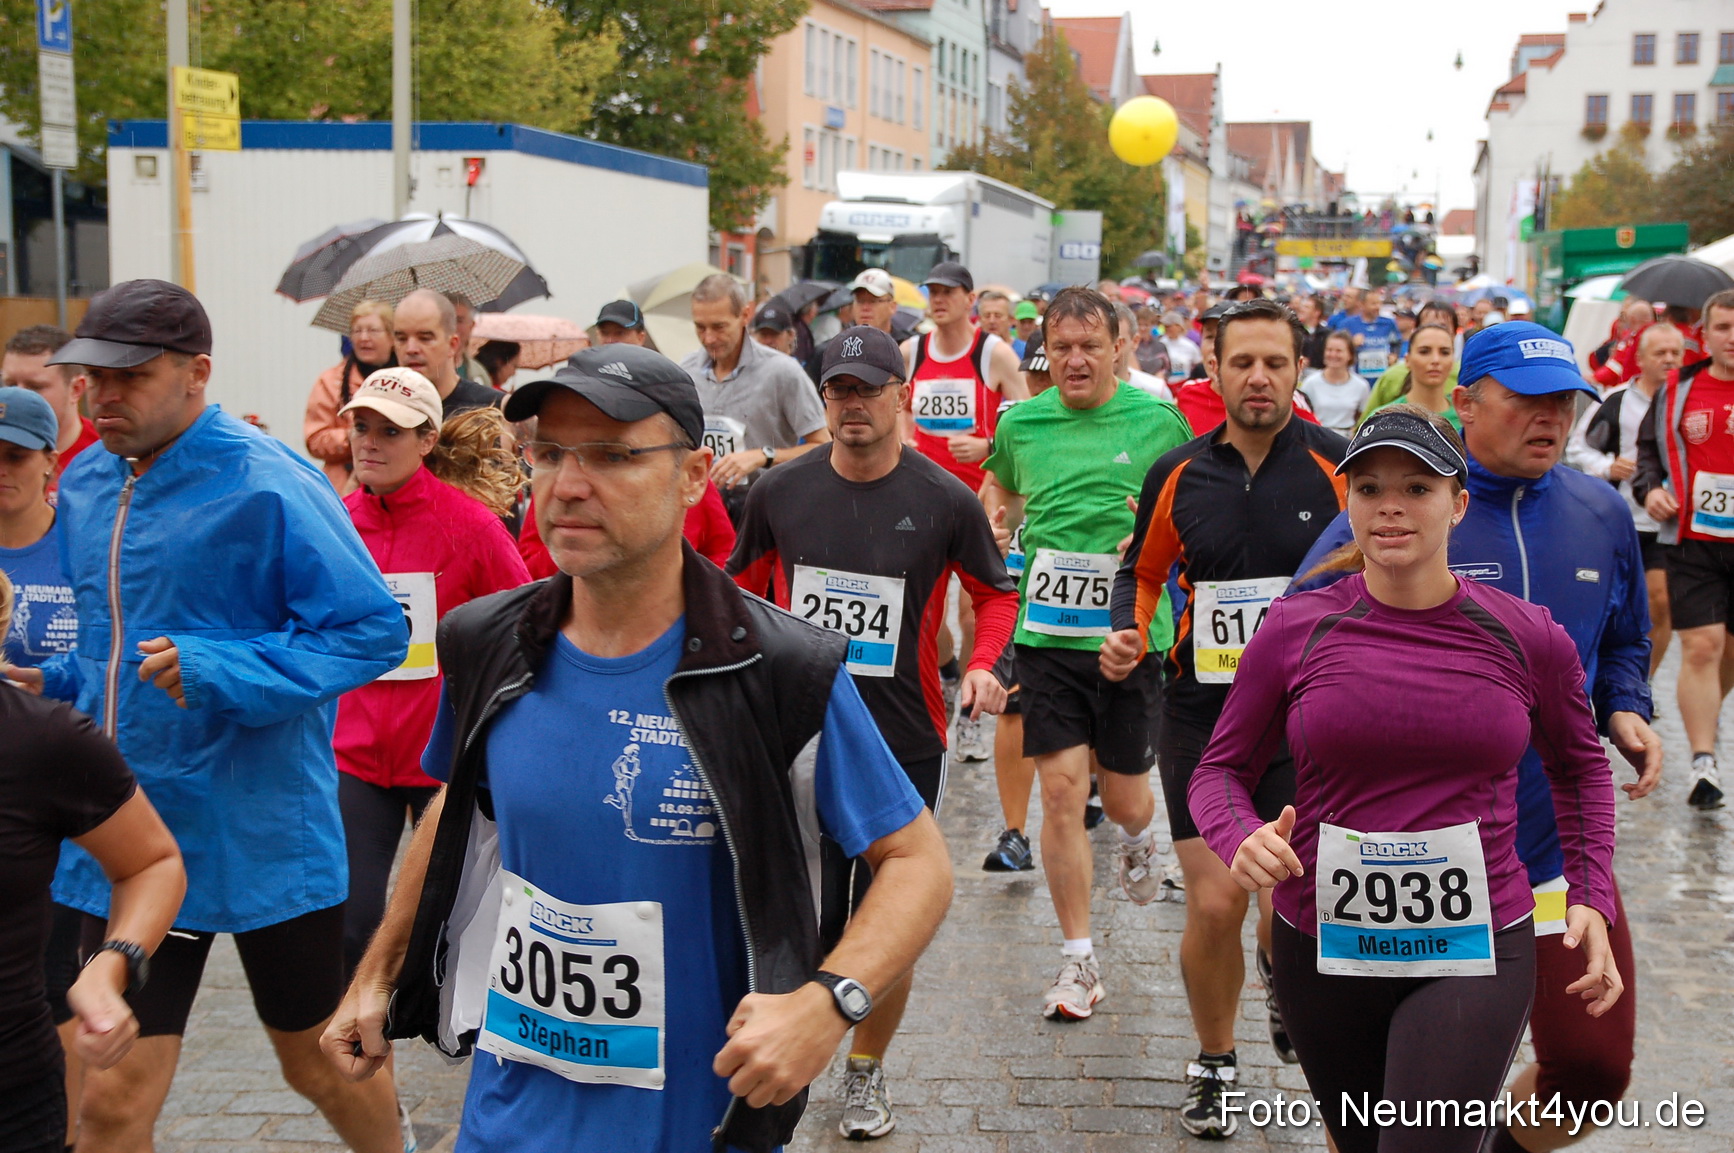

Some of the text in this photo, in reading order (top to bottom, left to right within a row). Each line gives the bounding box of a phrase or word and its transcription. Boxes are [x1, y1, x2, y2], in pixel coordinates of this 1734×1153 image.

[919, 396, 968, 416] 2835
[1054, 556, 1090, 568] BOCK
[825, 577, 870, 591] BOCK
[1035, 571, 1108, 607] 2475
[1216, 586, 1258, 598] BOCK
[802, 593, 890, 639] 2534
[1057, 612, 1079, 624] Jan
[608, 709, 633, 726] 12.
[1360, 842, 1428, 857] BOCK
[1331, 867, 1473, 924] 2938
[530, 901, 594, 934] BOCK
[1358, 935, 1448, 956] Melanie
[500, 926, 642, 1019] 3053
[518, 1012, 609, 1058] Stephan
